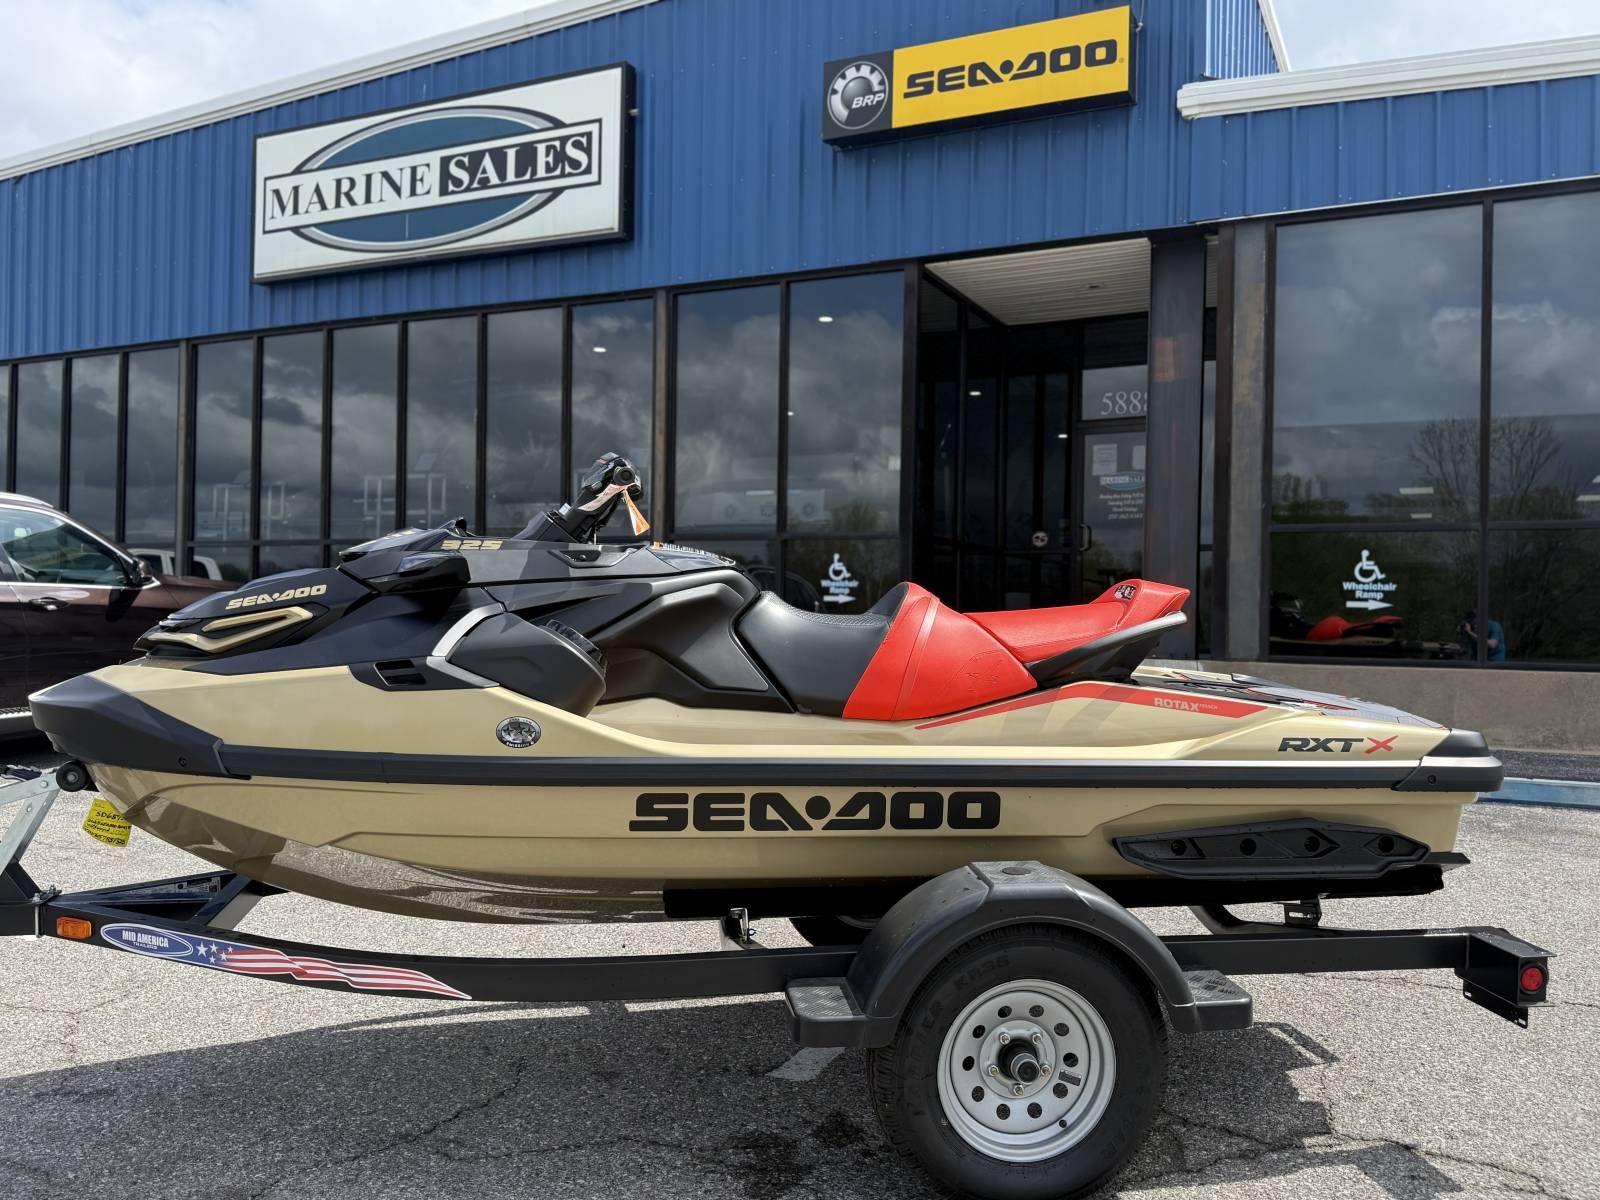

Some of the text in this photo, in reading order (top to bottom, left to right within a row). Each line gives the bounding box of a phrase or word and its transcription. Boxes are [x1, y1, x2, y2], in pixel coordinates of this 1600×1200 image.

[851, 92, 885, 109] BRP
[268, 134, 590, 220] MARINE SALES
[1100, 390, 1147, 415] 588
[440, 540, 504, 550] 325
[1342, 581, 1397, 590] Wheelchair
[1355, 590, 1384, 600] Ramp
[1154, 697, 1199, 713] ROTAX
[1278, 735, 1399, 755] RXT X
[122, 930, 169, 948] MID AMERICA
